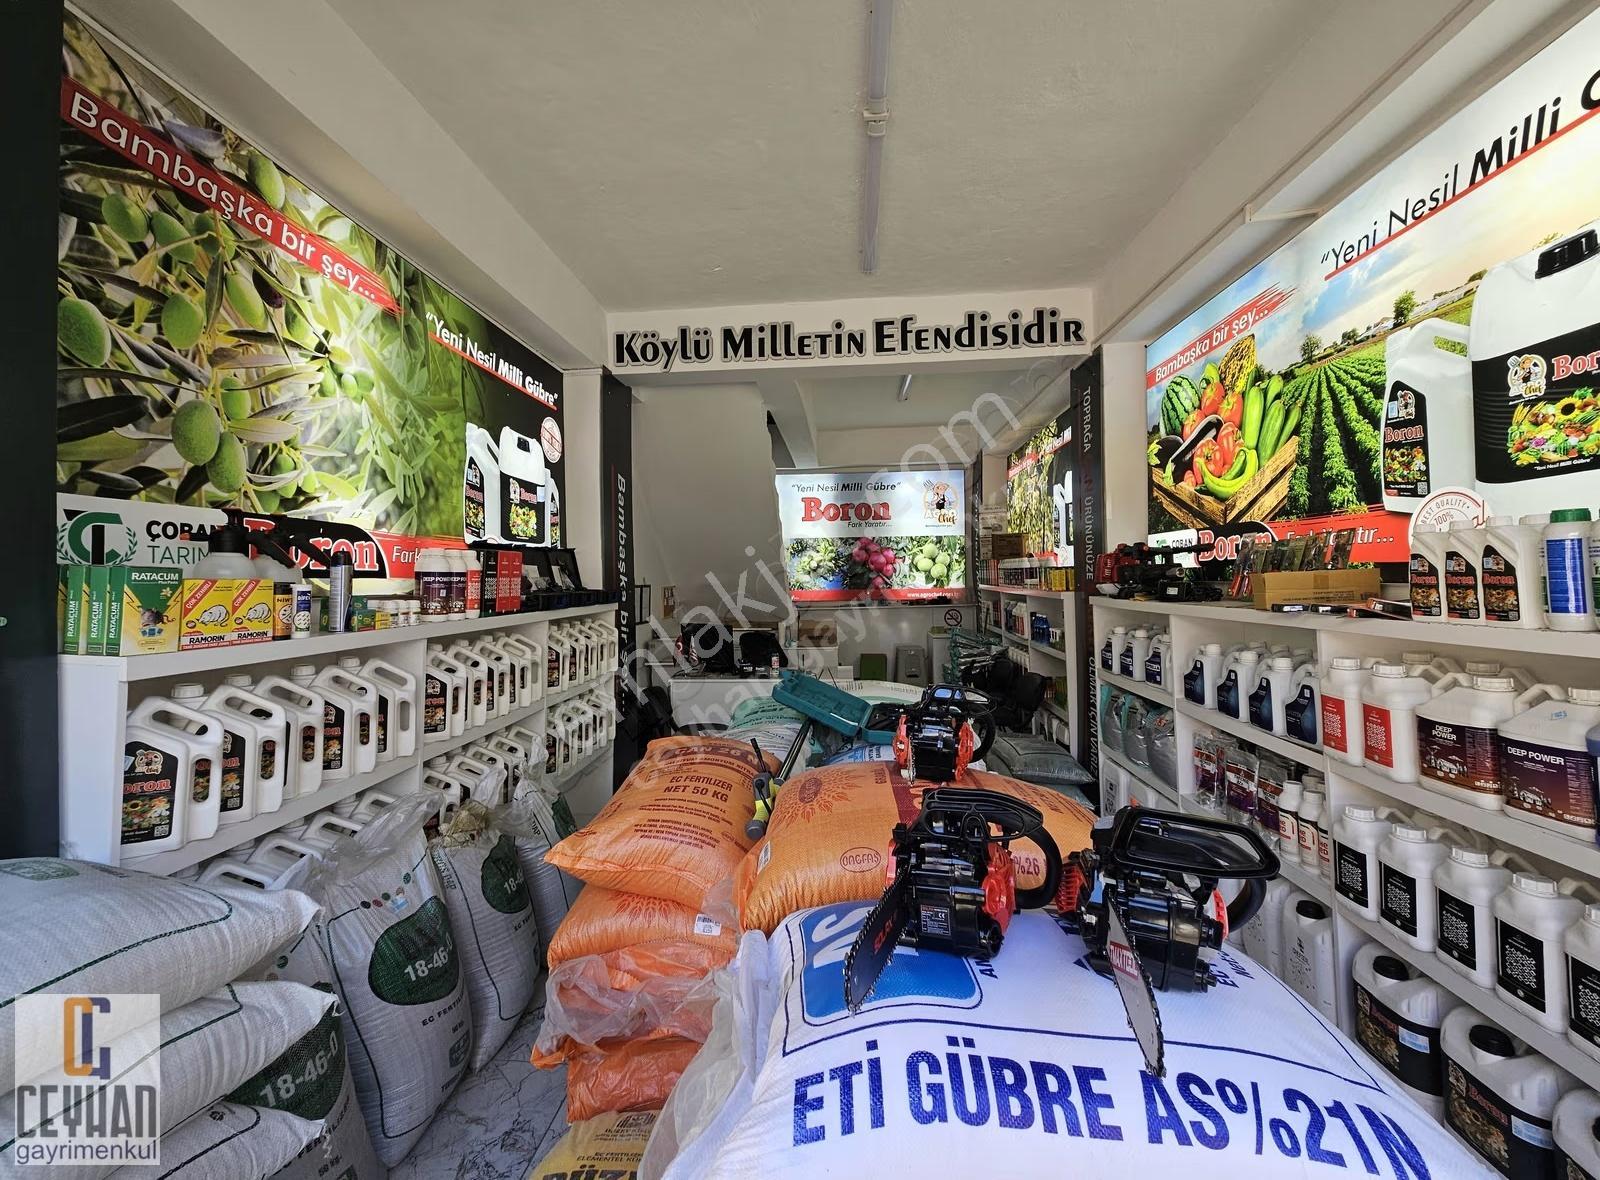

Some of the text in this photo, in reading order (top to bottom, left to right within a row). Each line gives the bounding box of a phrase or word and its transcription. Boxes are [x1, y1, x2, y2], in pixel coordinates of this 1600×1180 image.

[1387, 164, 1460, 237] Nesil
[1468, 96, 1562, 188] Milli
[69, 91, 376, 300] Bambaşka bir şey...
[466, 336, 497, 373] Nesil
[497, 358, 523, 386] Milli
[614, 326, 712, 372] Köylü
[1154, 340, 1210, 382] Bambaşka
[1212, 326, 1229, 347] bir
[1083, 386, 1093, 453] TOPRAĞA
[1384, 424, 1425, 443] Boron
[816, 483, 839, 492] Nesil
[840, 482, 863, 492] Milli
[801, 497, 892, 522] Boron
[1435, 498, 1467, 511] QUALITY
[617, 474, 628, 602] Bambaşka
[1084, 496, 1094, 580] ÜRÜNÜNÜZE
[392, 545, 423, 564] Fark
[131, 572, 179, 581] RATACUM
[1482, 574, 1515, 585] Boron
[67, 600, 77, 637] RATACUM
[90, 601, 100, 638] RATACUM
[108, 602, 118, 639] RATACUM
[620, 610, 630, 644] bir
[1432, 730, 1457, 741] POWER
[1435, 724, 1453, 733] DEEP
[1507, 746, 1565, 766] DEEP POWER
[124, 778, 171, 794] oron
[663, 785, 729, 803] NET 50 KG
[684, 775, 733, 792] FERTILIZER
[421, 1016, 436, 1026] EC
[259, 1031, 338, 1107] 18-46-0
[793, 1040, 886, 1148] ETİ
[906, 1035, 1124, 1142] GÜBRE
